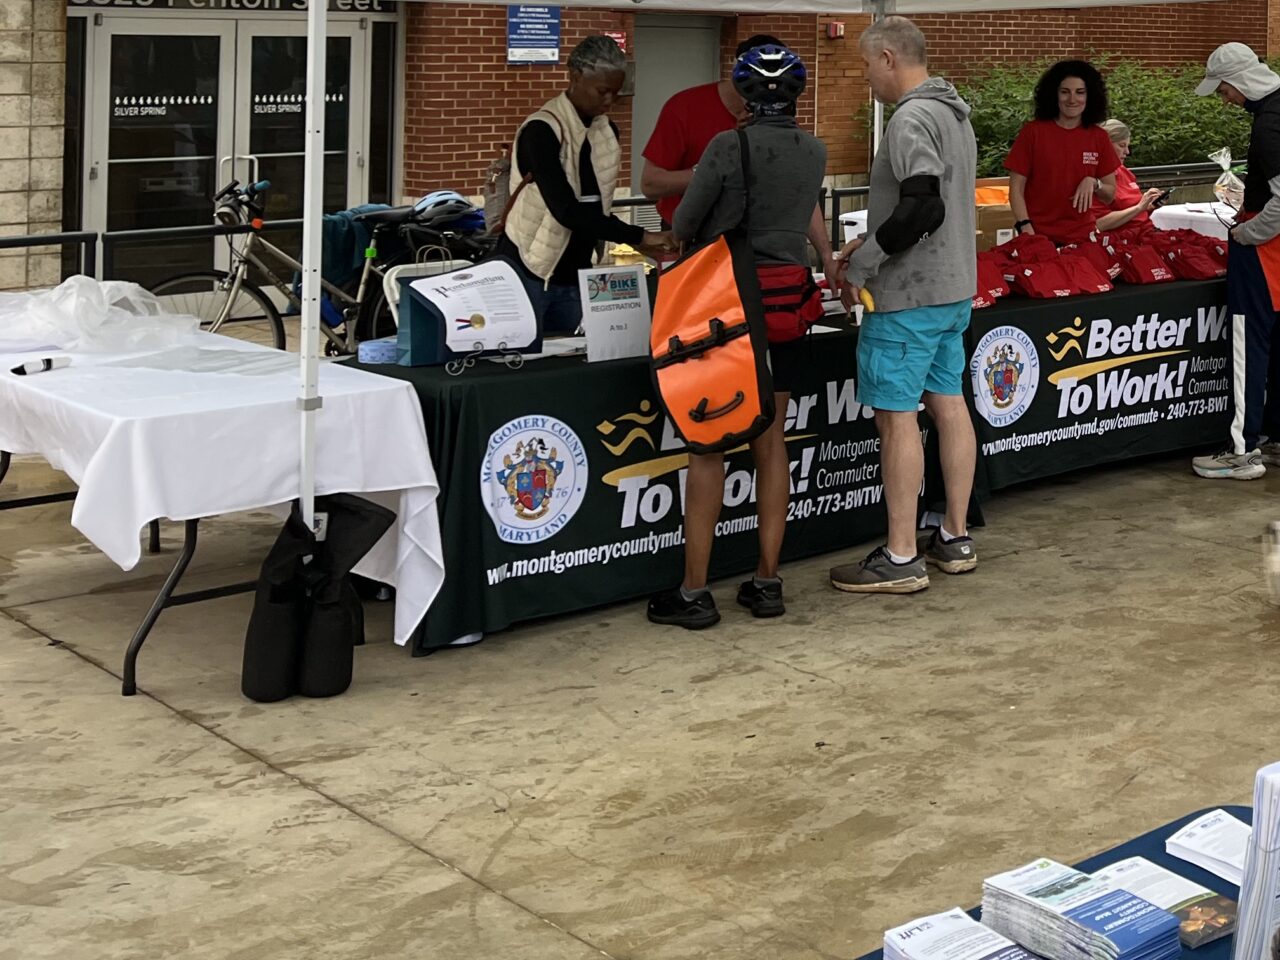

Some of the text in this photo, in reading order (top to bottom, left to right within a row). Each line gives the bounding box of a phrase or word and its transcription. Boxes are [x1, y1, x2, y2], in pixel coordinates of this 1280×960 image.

[114, 107, 166, 116] SILVER SPRING
[254, 105, 302, 114] SILVER SPRING
[610, 279, 638, 289] BIKE
[591, 302, 641, 313] REGISTRATION
[1086, 313, 1192, 359] Better
[971, 326, 1039, 379] MONTGOMERY COUNTY
[482, 417, 587, 484] MONTGOMERY COUNTY
[819, 438, 881, 464] Montgome
[816, 463, 880, 489] Commuter
[617, 475, 673, 529] To
[786, 484, 884, 522] 240-773-BWTW
[499, 512, 568, 542] MARYLAND
